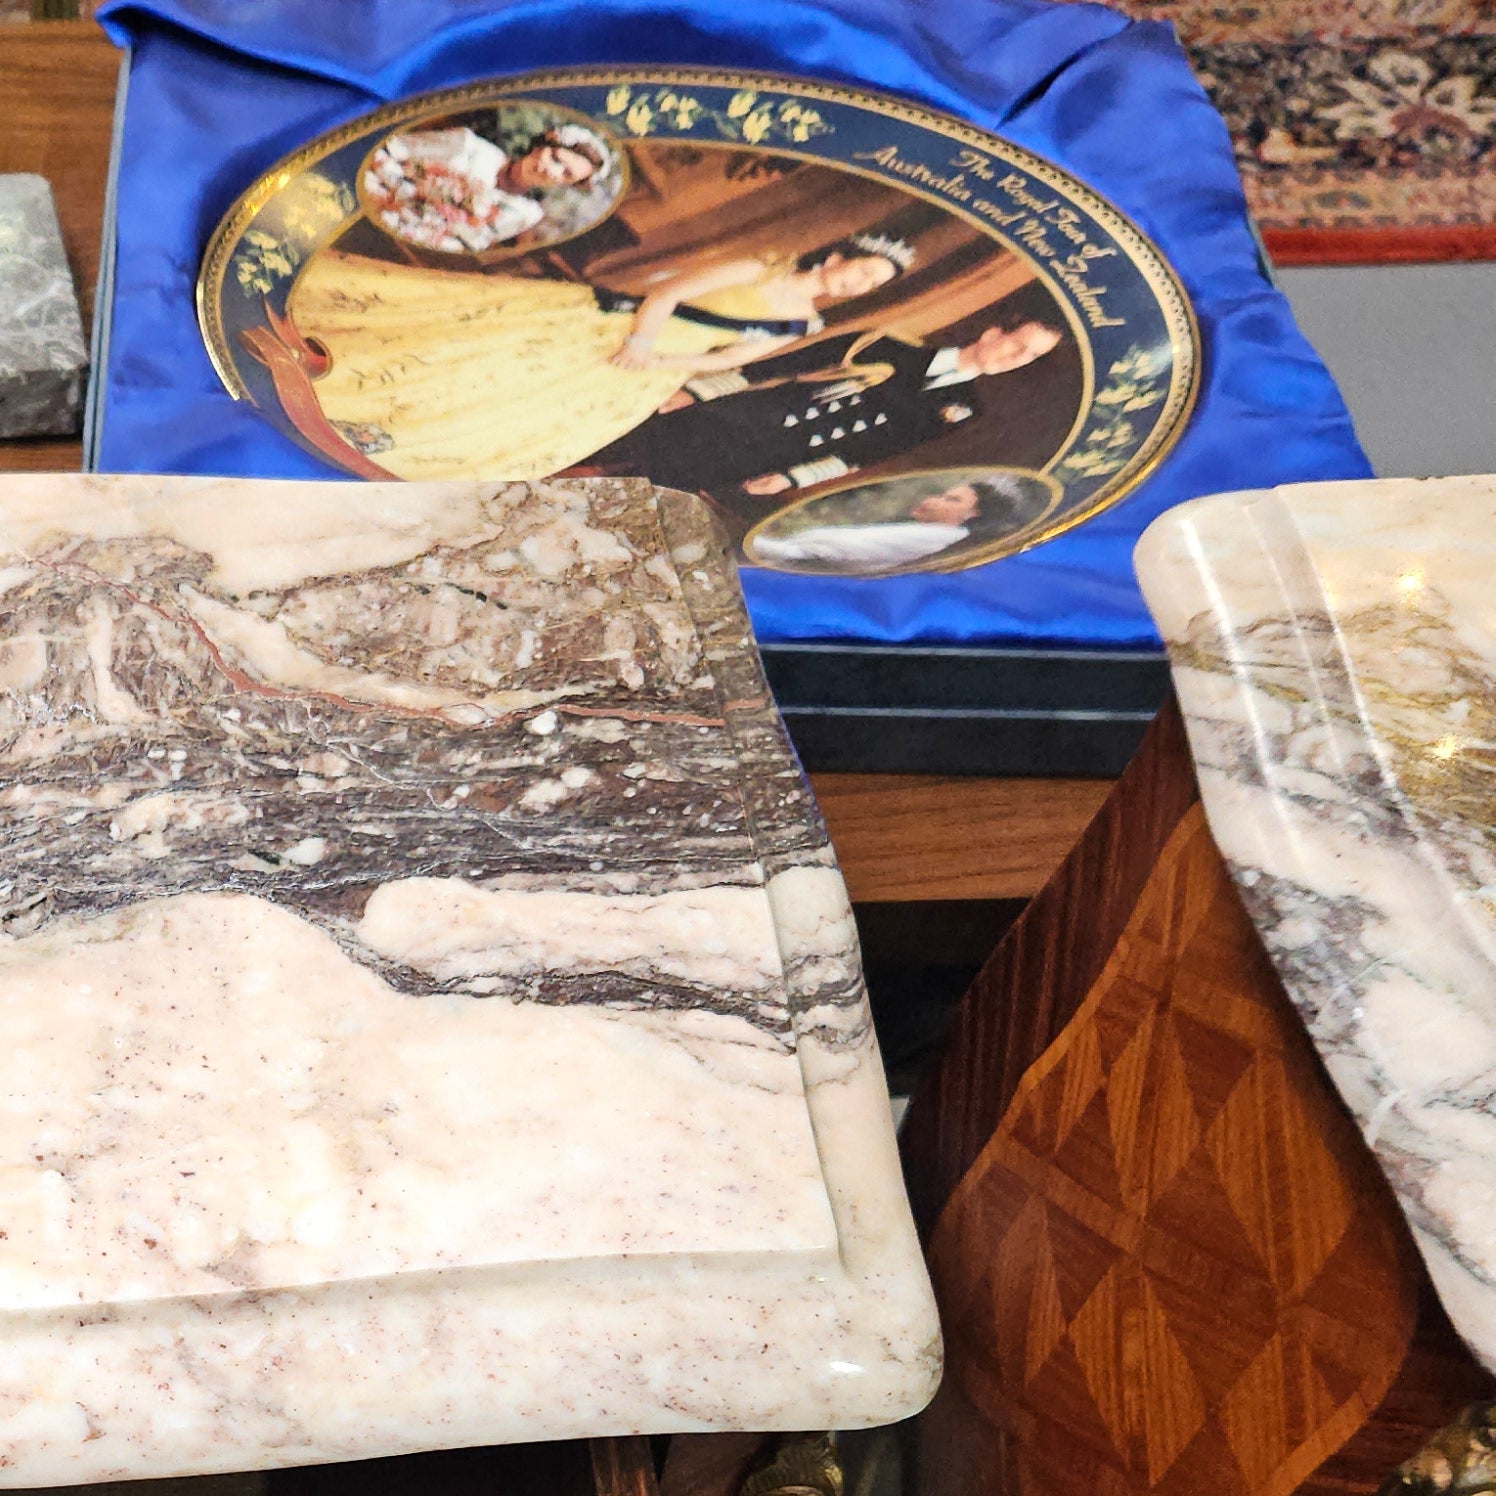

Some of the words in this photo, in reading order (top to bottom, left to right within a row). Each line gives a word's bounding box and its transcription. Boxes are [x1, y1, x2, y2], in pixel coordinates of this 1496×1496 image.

[852, 146, 972, 201] Australia
[972, 198, 1027, 226] and
[1014, 217, 1057, 257] New
[1049, 254, 1126, 329] Zealand
[947, 150, 994, 181] The
[996, 173, 1060, 214] Royal
[1043, 206, 1087, 245] Tour
